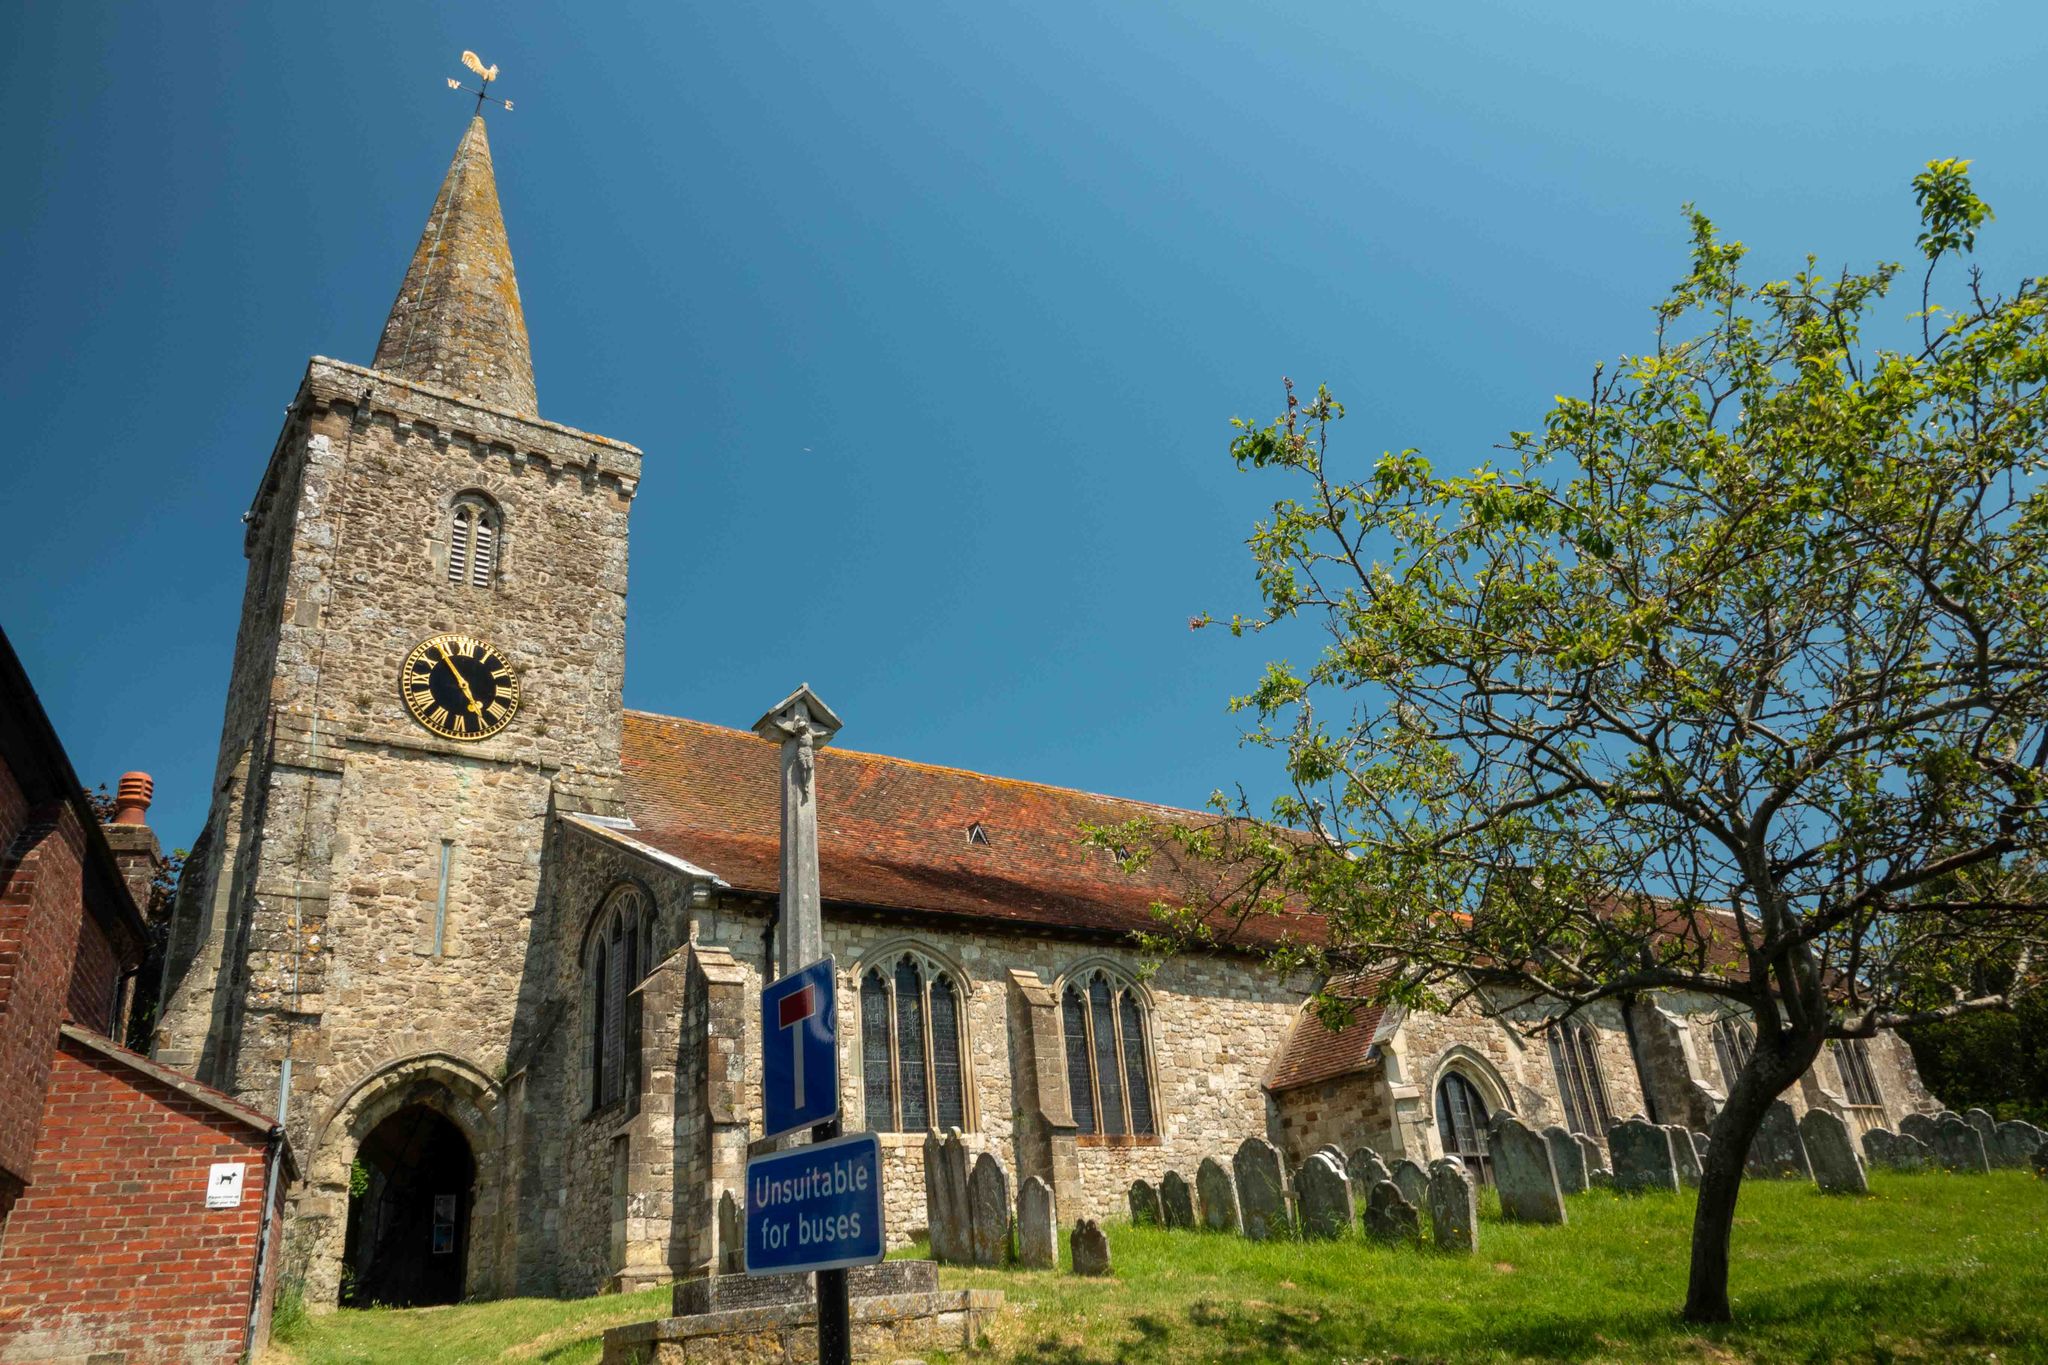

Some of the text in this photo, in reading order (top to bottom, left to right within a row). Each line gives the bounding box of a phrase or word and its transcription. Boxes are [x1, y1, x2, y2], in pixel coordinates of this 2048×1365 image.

[457, 641, 475, 658] XII
[480, 649, 494, 664] I
[418, 652, 438, 670] X
[411, 671, 431, 685] IX
[491, 668, 508, 679] II
[413, 690, 435, 711] VIII
[495, 684, 512, 699] III
[430, 706, 449, 727] VII
[453, 714, 466, 732] VI
[756, 1160, 868, 1208] Unsuitable
[761, 1212, 861, 1249] for buses
